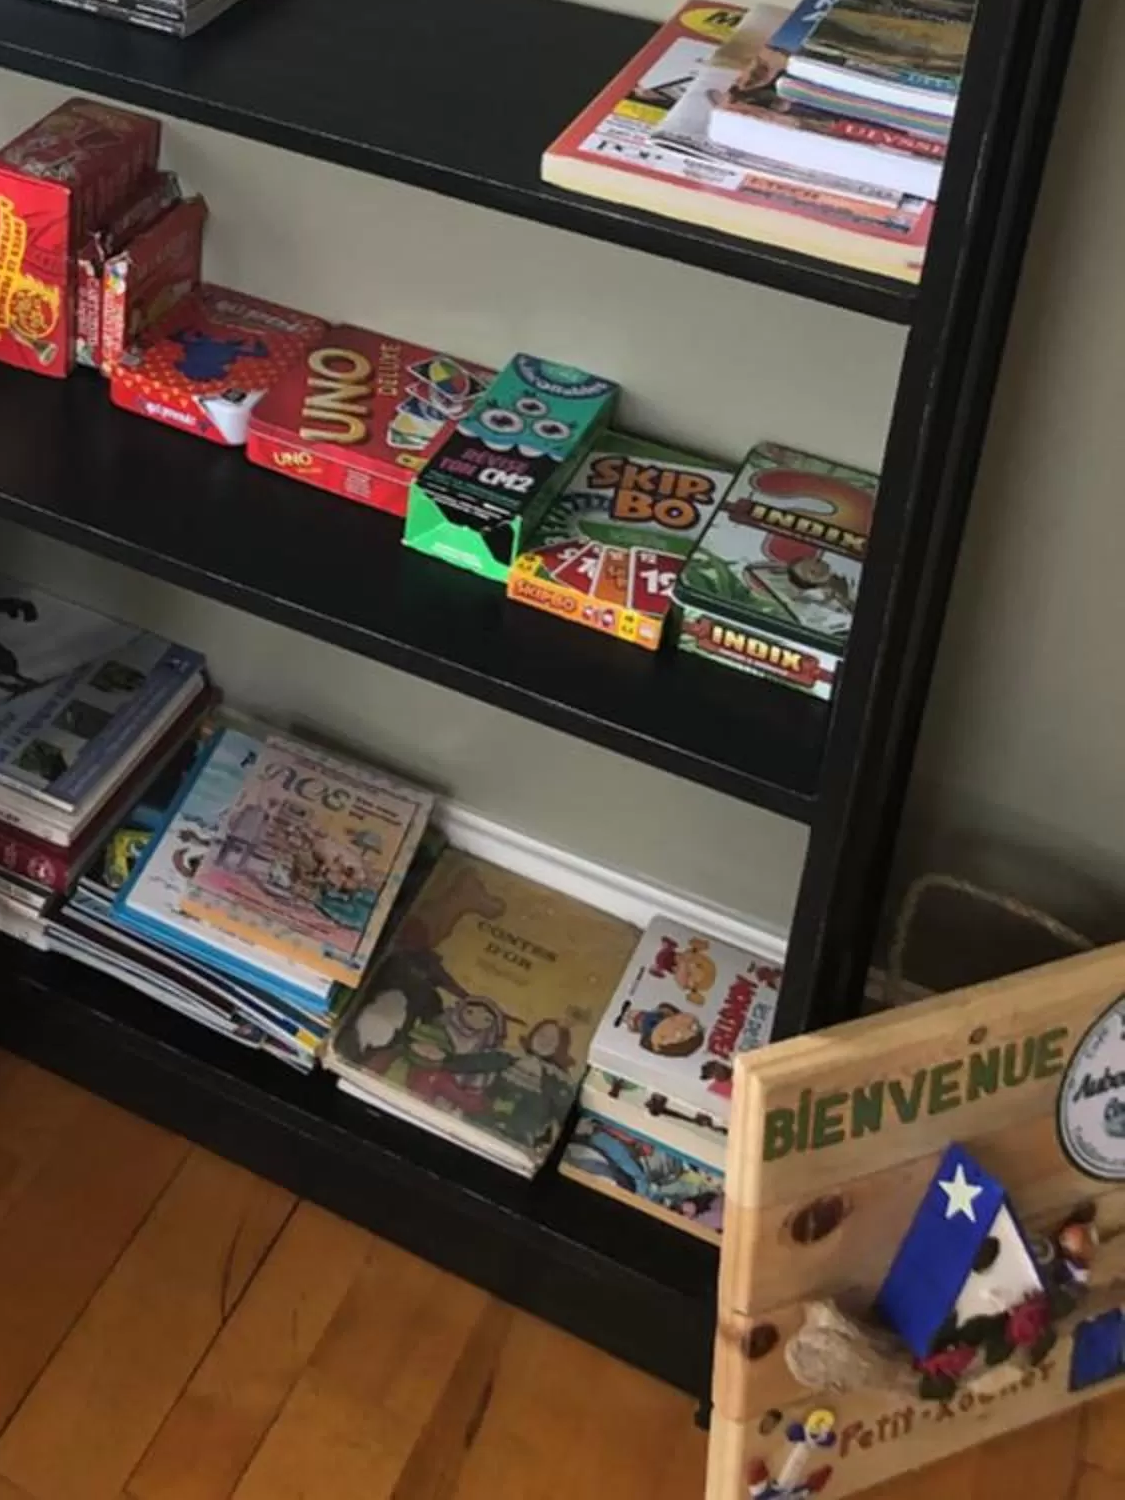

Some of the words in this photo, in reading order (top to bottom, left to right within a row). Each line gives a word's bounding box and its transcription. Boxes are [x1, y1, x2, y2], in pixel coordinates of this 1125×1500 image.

[378, 342, 402, 396] DELUXE
[299, 348, 376, 443] UNO
[273, 450, 313, 467] UNO
[479, 467, 535, 493] CM2
[613, 490, 701, 530] BO
[750, 503, 868, 552] INDIX
[640, 568, 677, 598] 12
[711, 625, 803, 673] INDIX
[477, 920, 560, 964] CONTES
[483, 941, 533, 973] D'OR
[763, 1027, 1071, 1163] BIENVENUE
